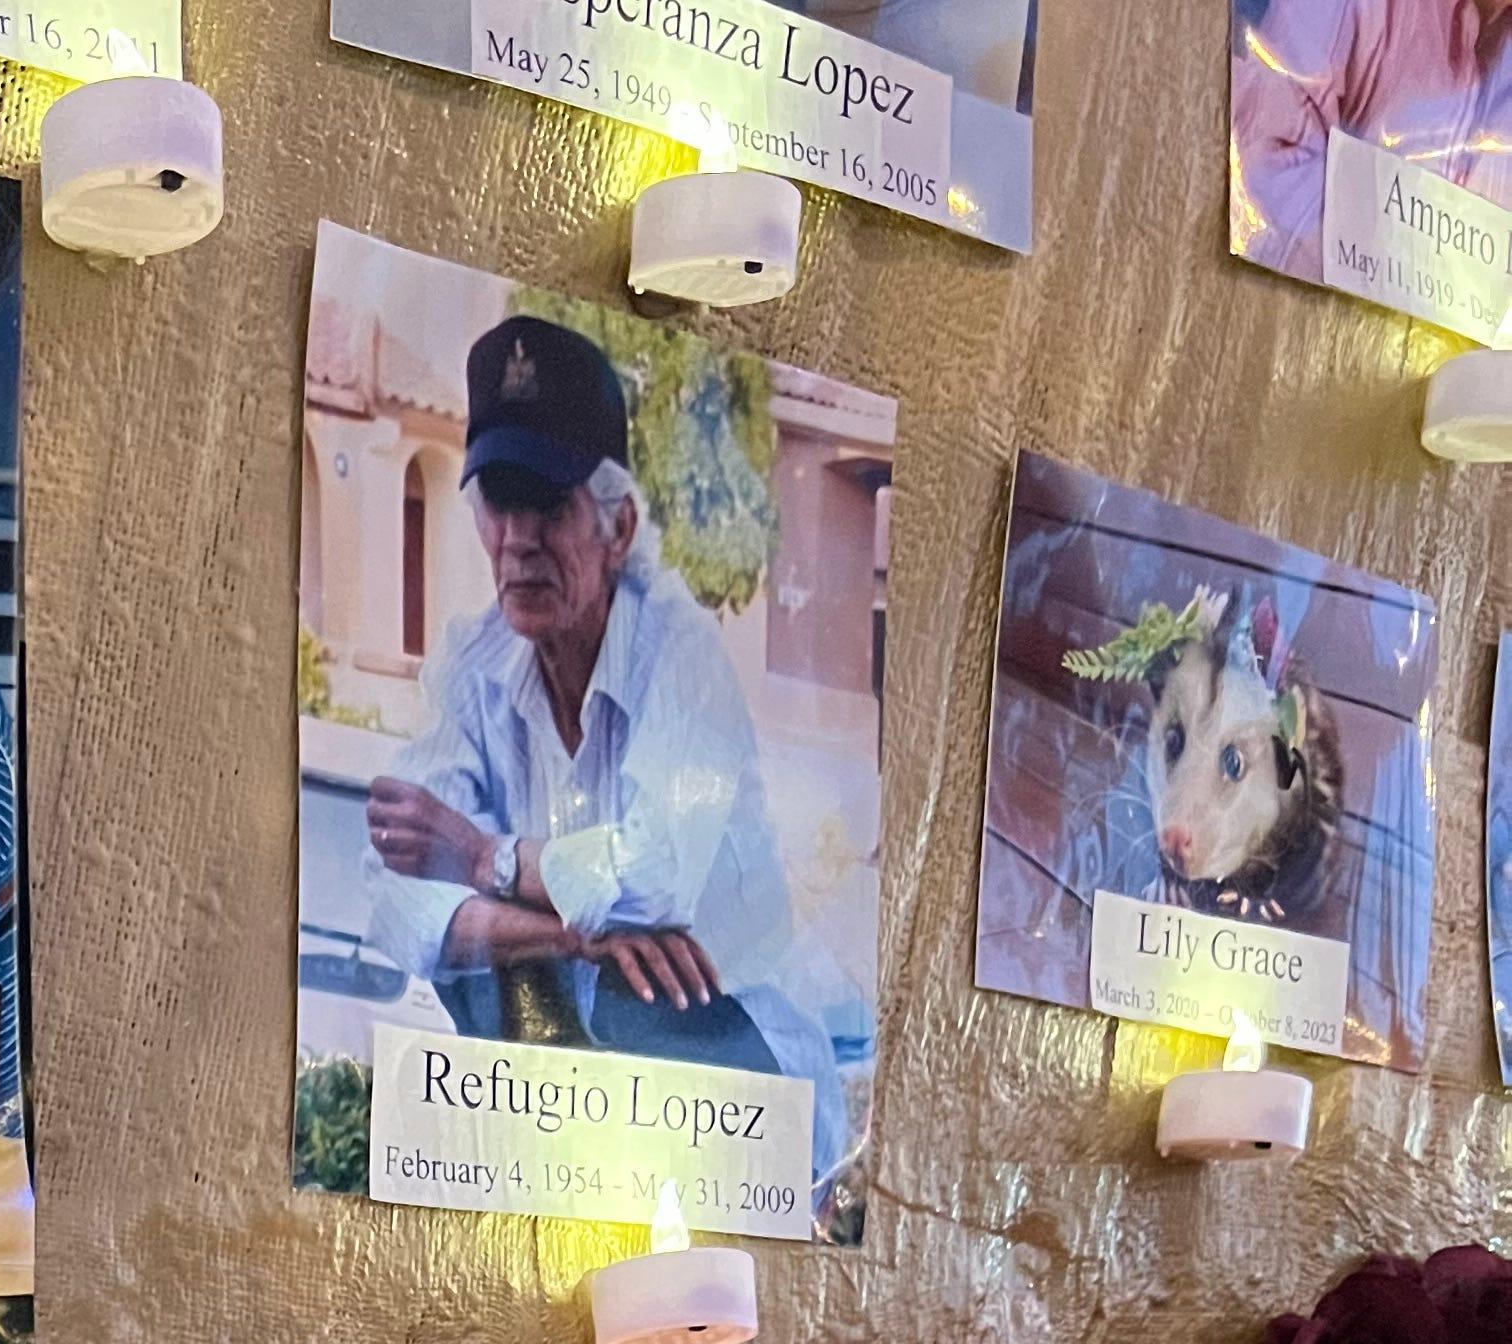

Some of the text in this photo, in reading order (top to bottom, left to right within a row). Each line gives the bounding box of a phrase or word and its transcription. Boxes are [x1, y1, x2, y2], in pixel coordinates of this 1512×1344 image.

[26, 13, 73, 60] 16,
[83, 27, 159, 74] 21
[777, 24, 915, 125] Lopez
[486, 30, 548, 83] May
[559, 52, 600, 100] 25,
[612, 69, 672, 117] 1949
[698, 101, 829, 171] Sptember
[839, 147, 875, 193] 16,
[882, 161, 938, 208] 2005
[1383, 172, 1496, 267] Amparo
[1338, 239, 1380, 282] May
[1388, 260, 1411, 295] 11,
[1415, 270, 1455, 308] 1919
[1136, 911, 1304, 984] Lily Grace
[1095, 977, 1141, 1010] March
[1145, 990, 1161, 1015] 3,
[1165, 992, 1201, 1020] 2020
[1219, 1004, 1282, 1034] Ober
[1301, 1019, 1337, 1045] 2023
[420, 1048, 767, 1149] Refugio Lopez
[385, 1144, 499, 1195] February
[508, 1160, 532, 1195] 4,
[542, 1163, 604, 1196] 1954
[631, 1171, 687, 1210] My
[695, 1177, 731, 1214] 31,
[738, 1182, 796, 1216] 2009
